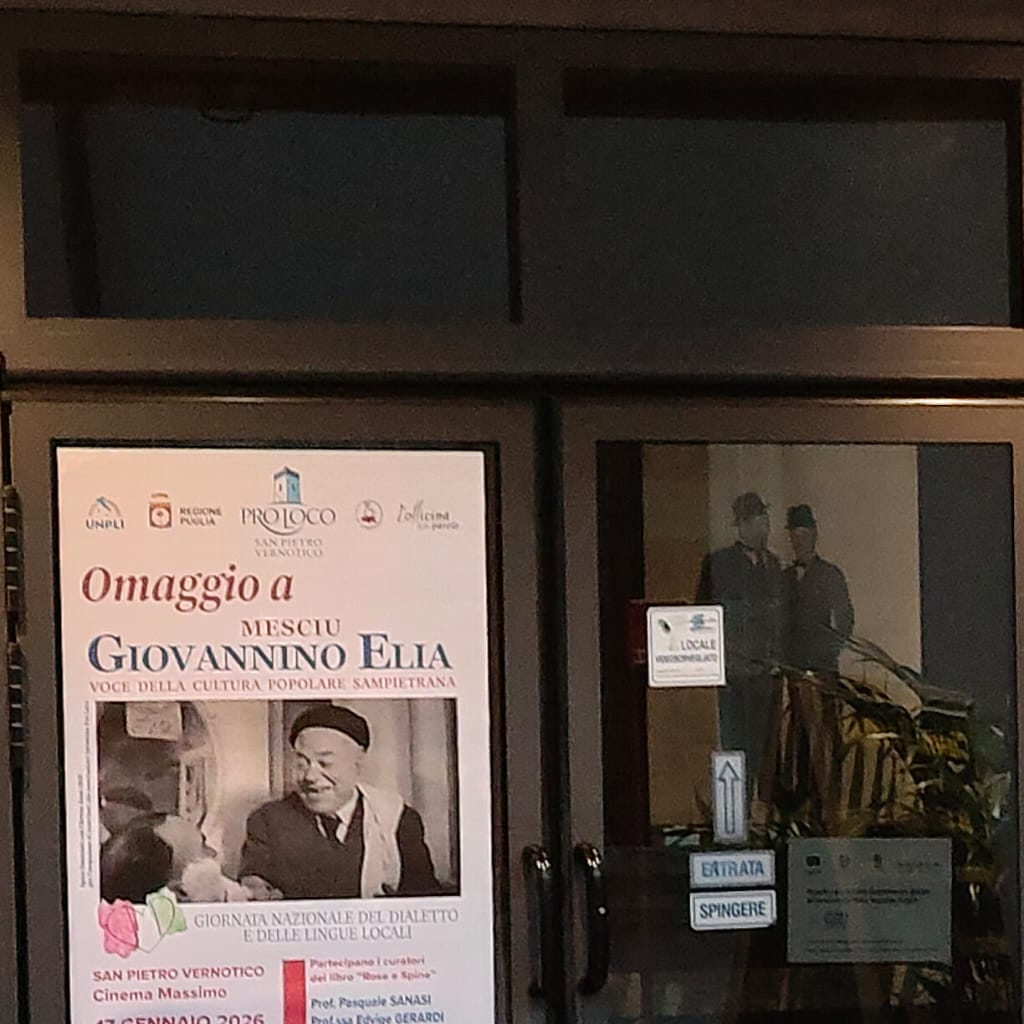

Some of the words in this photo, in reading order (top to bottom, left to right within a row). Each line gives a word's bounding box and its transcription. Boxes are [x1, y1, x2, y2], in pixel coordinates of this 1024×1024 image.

[180, 507, 222, 517] REGIONE
[86, 519, 125, 530] UNPLI
[180, 516, 219, 526] PUGLIA
[255, 538, 278, 548] SAN
[280, 537, 323, 547] PIETRO
[255, 548, 324, 558] VERNOTICO
[82, 564, 259, 613] Omaggio
[270, 573, 293, 601] a
[241, 619, 341, 637] MESCIU
[88, 633, 346, 673] GIOVANNINO
[358, 632, 453, 670] ELIA
[90, 680, 131, 693] VOCE
[138, 679, 186, 693] DELLA
[193, 678, 262, 692] CULTURA
[268, 677, 346, 691] POPOLARE
[353, 675, 456, 690] SAMPIETRANA
[702, 860, 764, 877] ENTRATA
[194, 911, 268, 929] GIORNATA
[272, 910, 354, 927] NAZIONALE
[358, 909, 386, 925] DEL
[389, 908, 459, 924] DIALETTO
[700, 902, 766, 918] SPINGERE
[244, 929, 252, 942] E
[256, 928, 300, 942] DELLE
[304, 926, 357, 942] LINGUE
[361, 925, 412, 941] LOCALI
[310, 957, 374, 971] Partecipano
[383, 955, 425, 967] curatori
[93, 969, 123, 982] SAN
[127, 967, 178, 981] PIETRO
[182, 965, 265, 979] VERNOTICO
[310, 972, 325, 983] del
[93, 987, 153, 1002] Cinema
[158, 985, 227, 1000] Massimo
[311, 997, 336, 1009] Prof.
[340, 996, 386, 1011] Pasquale
[389, 994, 431, 1007] SANASI
[395, 1011, 444, 1024] GERARDI
